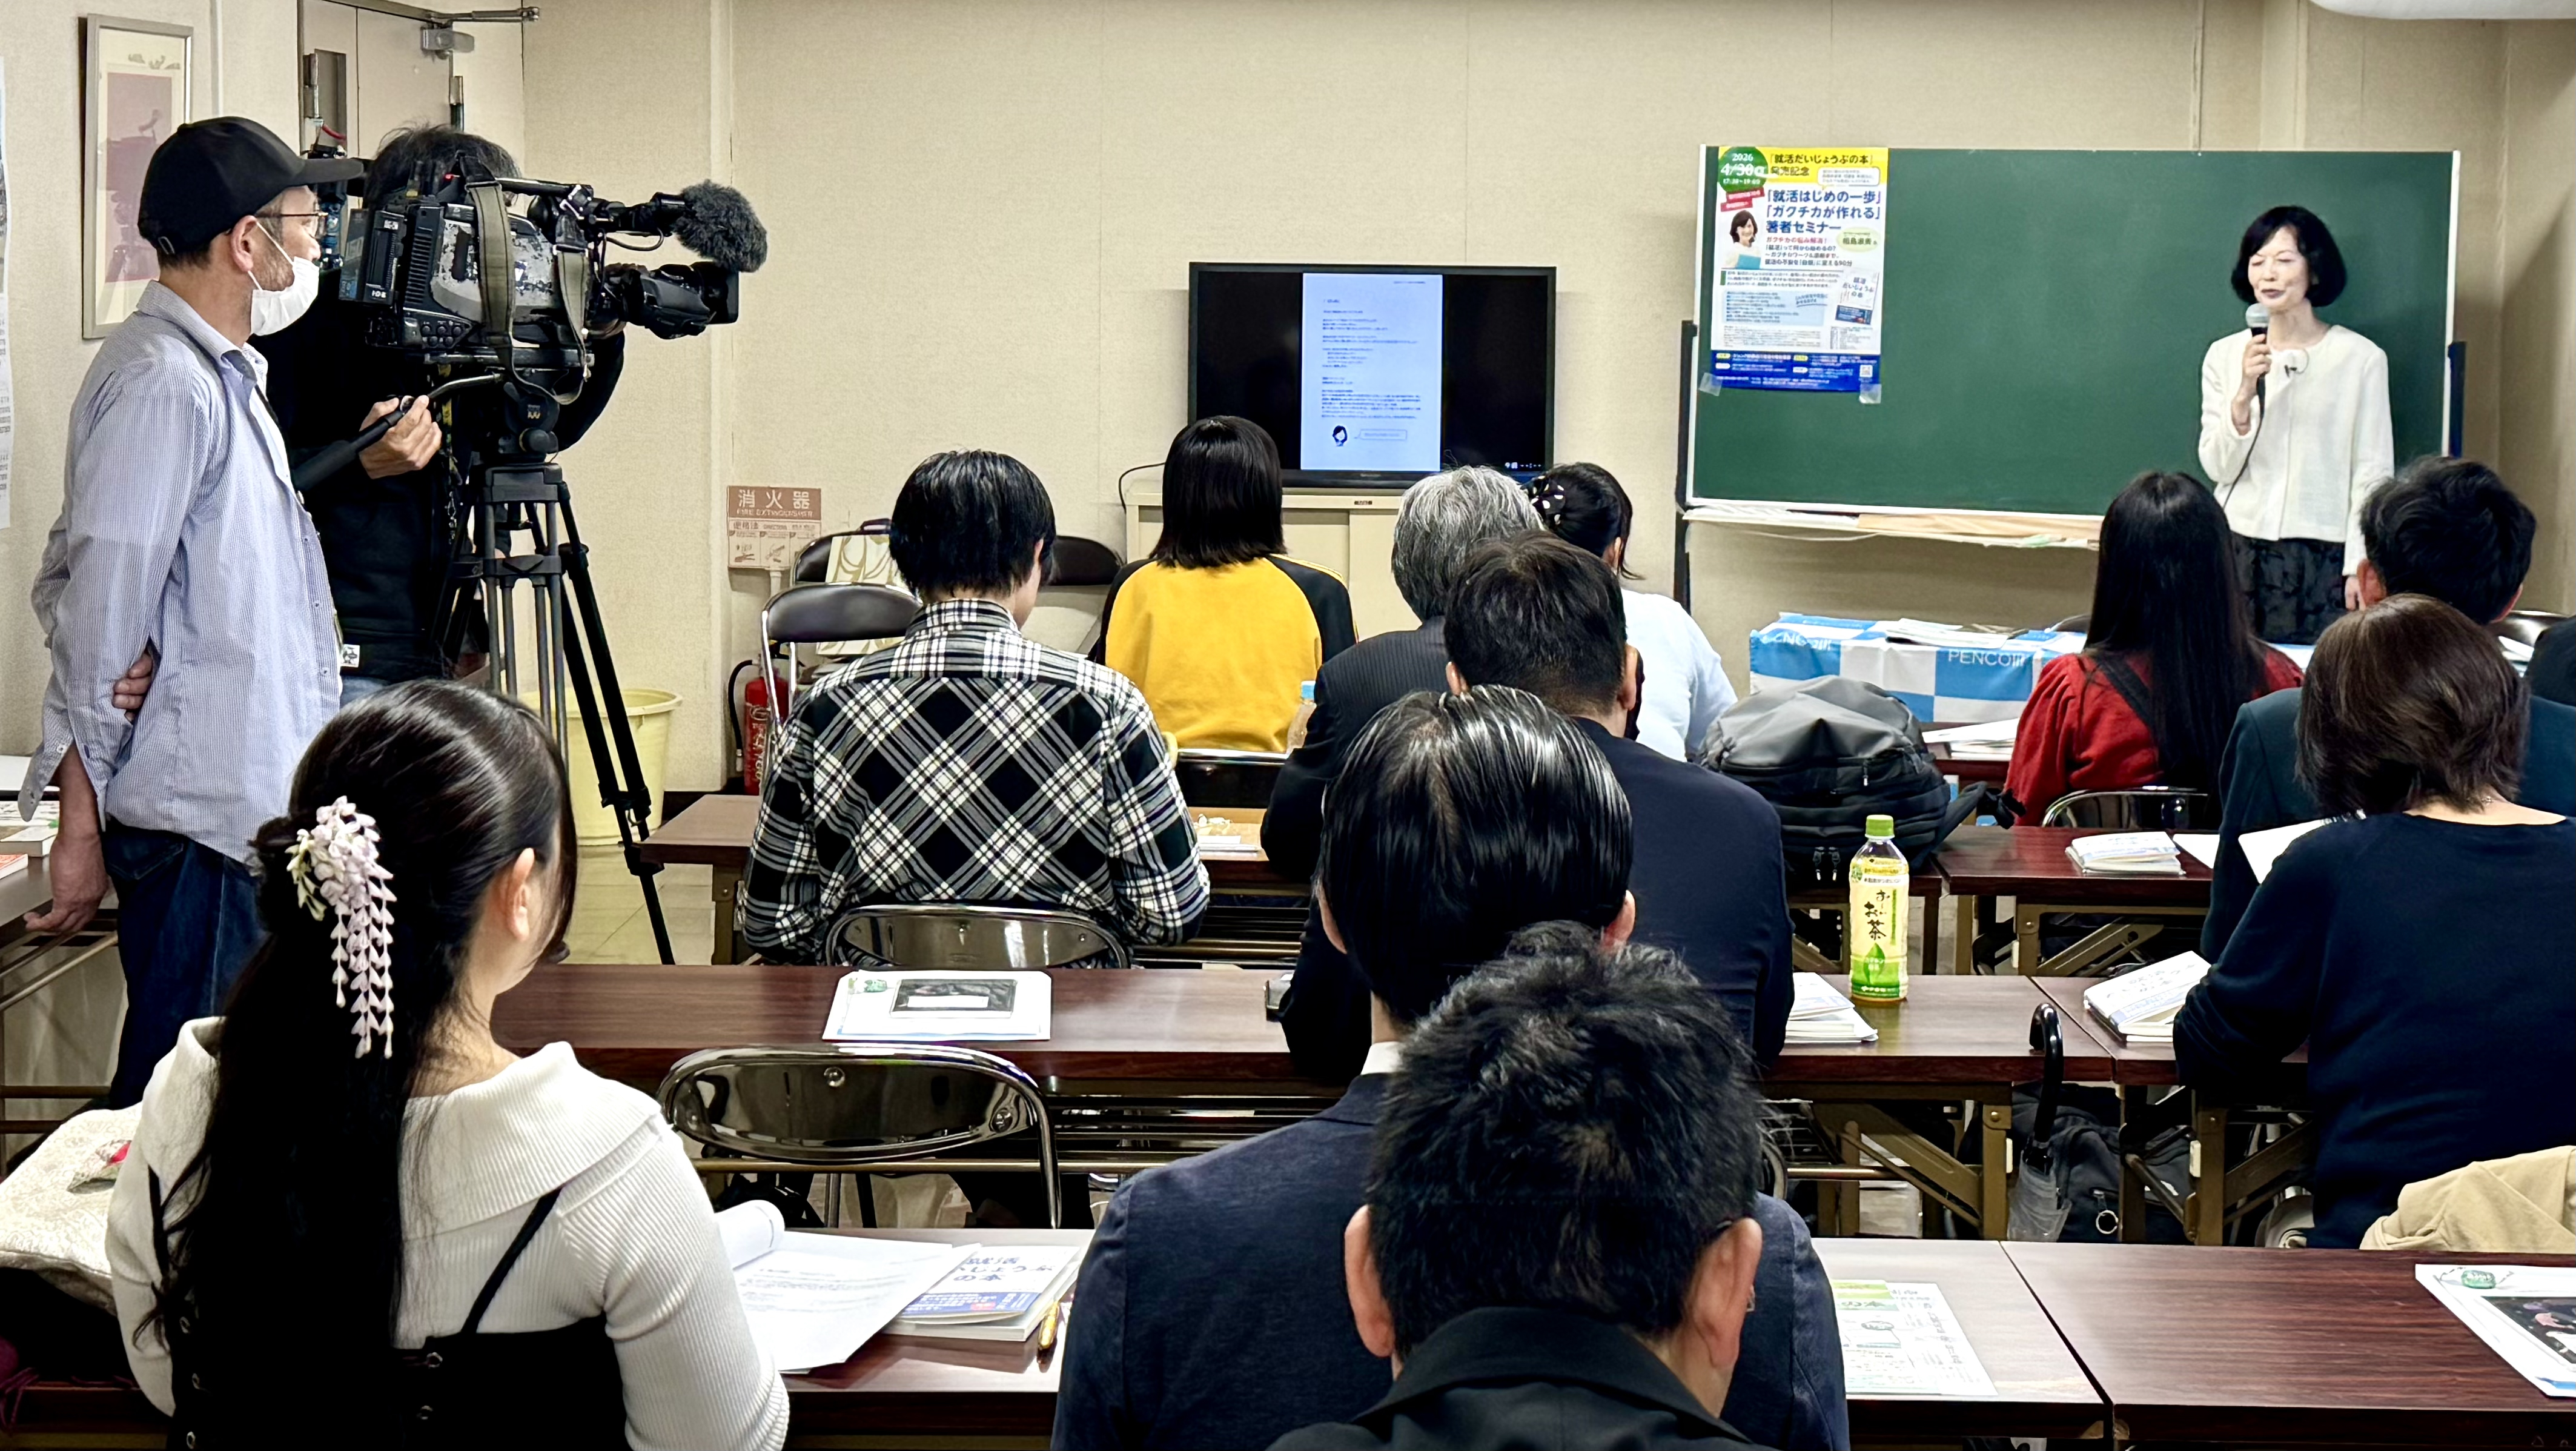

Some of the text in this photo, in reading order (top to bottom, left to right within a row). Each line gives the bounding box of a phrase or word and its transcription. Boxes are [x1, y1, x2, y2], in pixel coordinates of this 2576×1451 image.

[1767, 190, 1881, 204] 「就活はじめの一歩」
[1766, 205, 1880, 219] 「ガクチカが作れる」
[1766, 221, 1841, 234] 著者セミナー
[738, 489, 810, 510] 消火器
[1864, 901, 1887, 941] お茶
